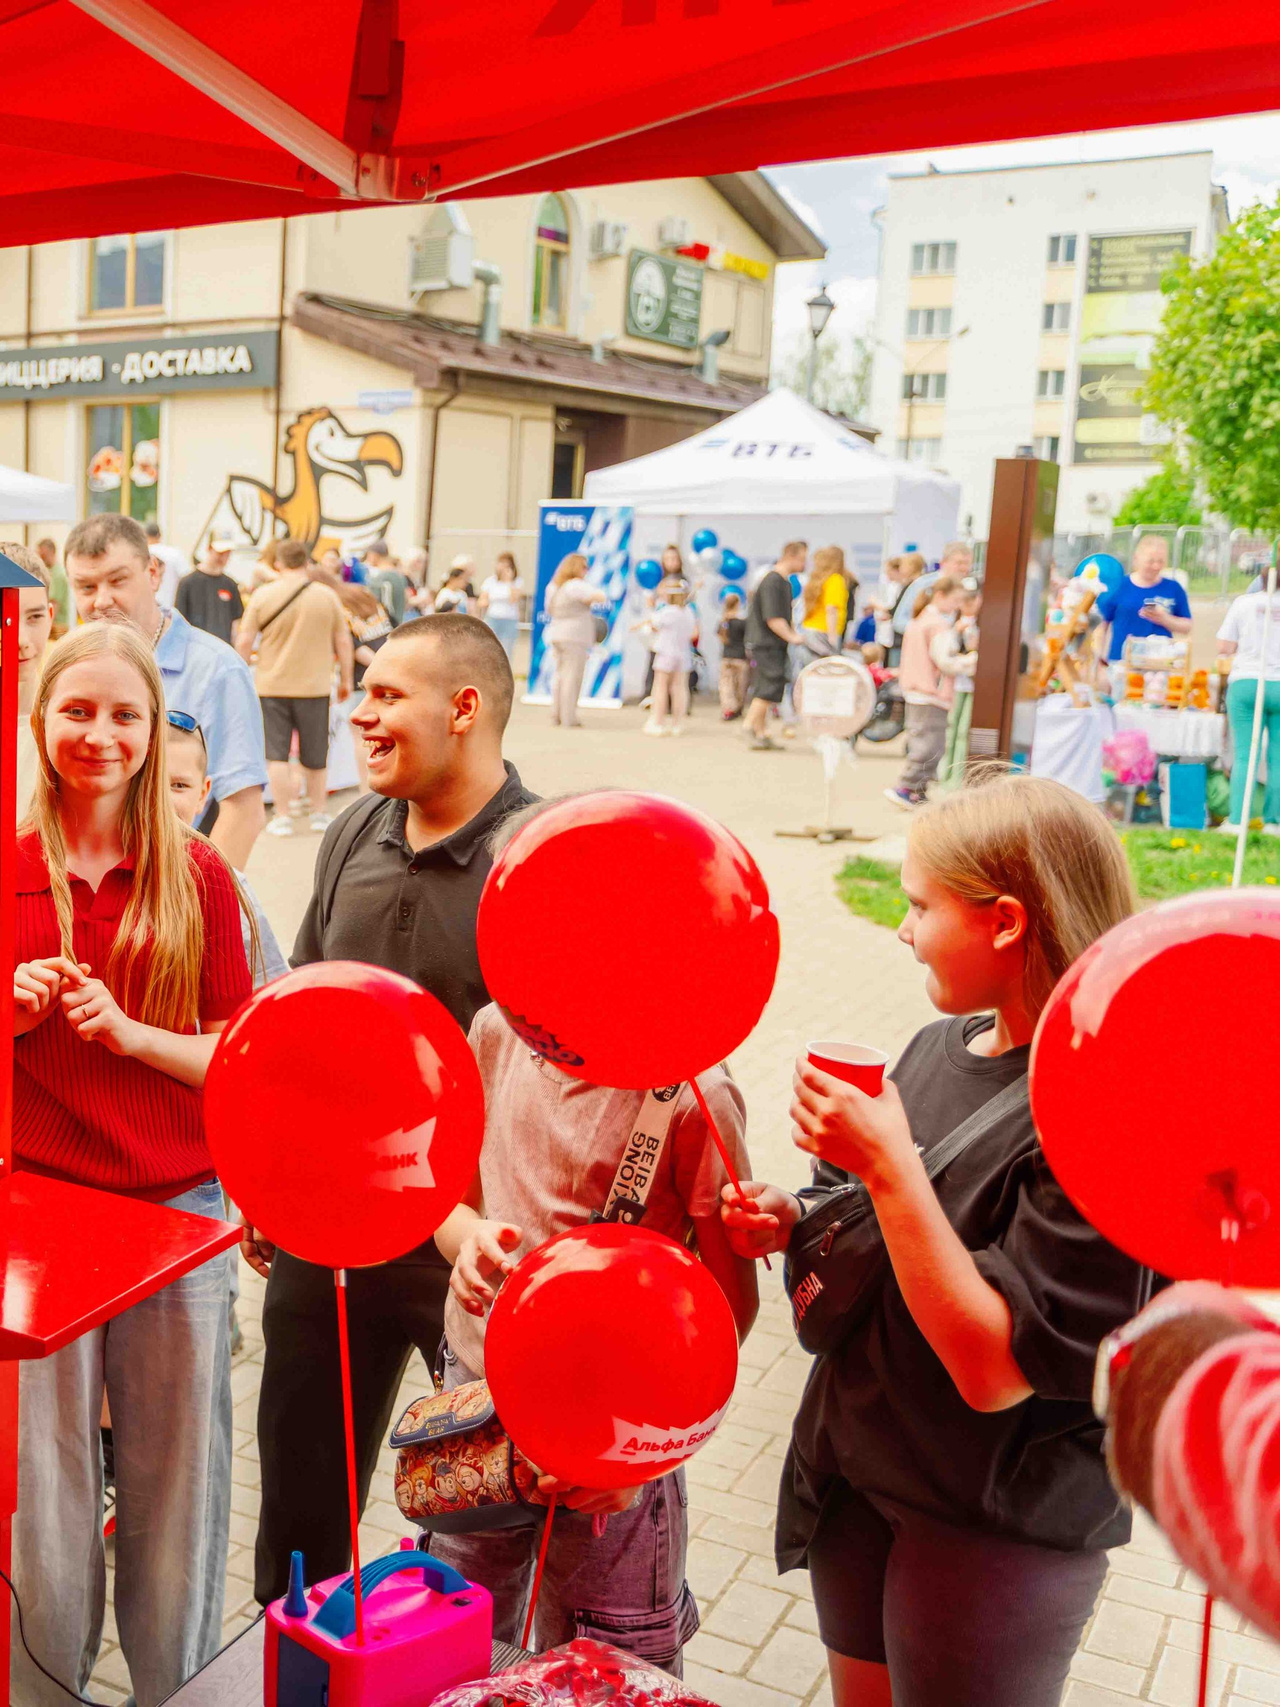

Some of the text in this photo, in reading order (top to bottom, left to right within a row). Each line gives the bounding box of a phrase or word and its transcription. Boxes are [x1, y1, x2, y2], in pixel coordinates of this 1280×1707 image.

[120, 344, 253, 385] ДОСТАВКА
[792, 1271, 824, 1321] ДУБНА
[620, 1437, 685, 1455] Альфа
